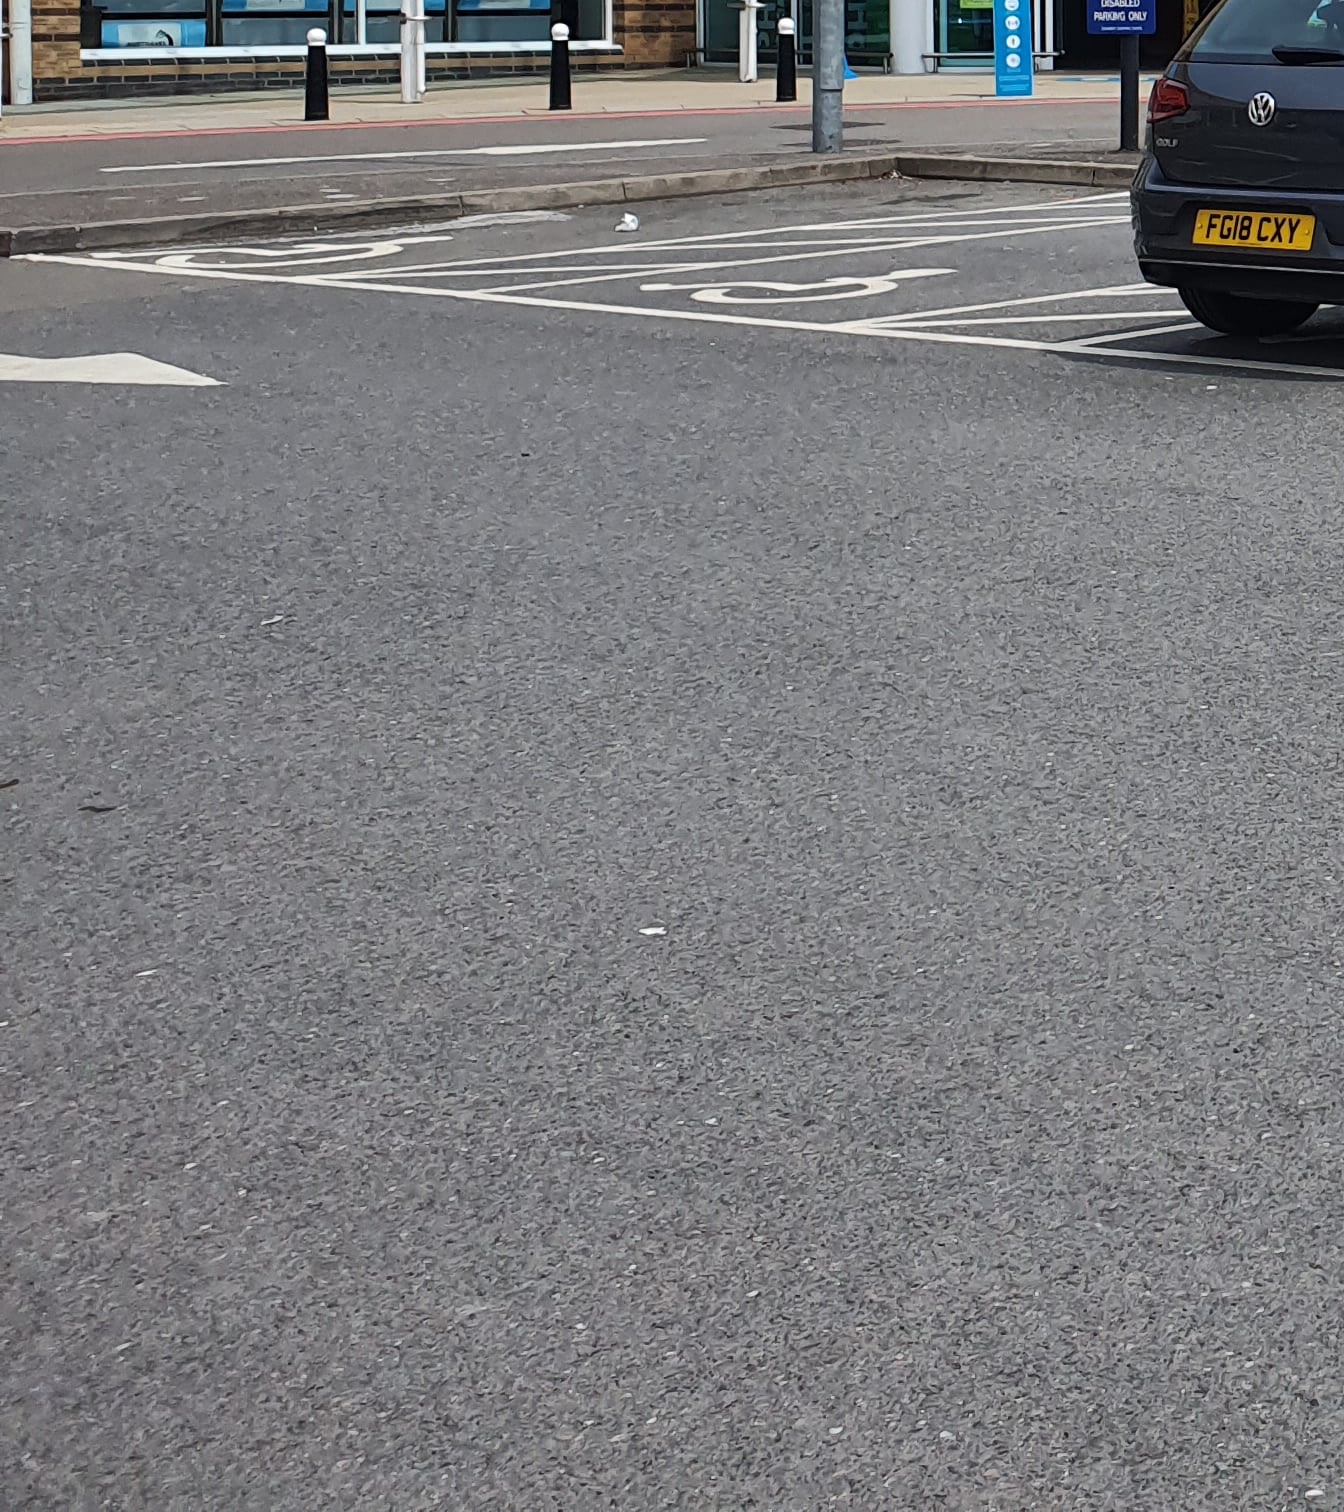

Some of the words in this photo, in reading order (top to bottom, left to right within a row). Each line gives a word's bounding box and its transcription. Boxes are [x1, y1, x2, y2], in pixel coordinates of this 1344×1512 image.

[1094, 11, 1126, 21] PARKING
[1128, 11, 1147, 21] ONLY
[1205, 213, 1253, 240] FG18
[1256, 216, 1301, 244] CXY
